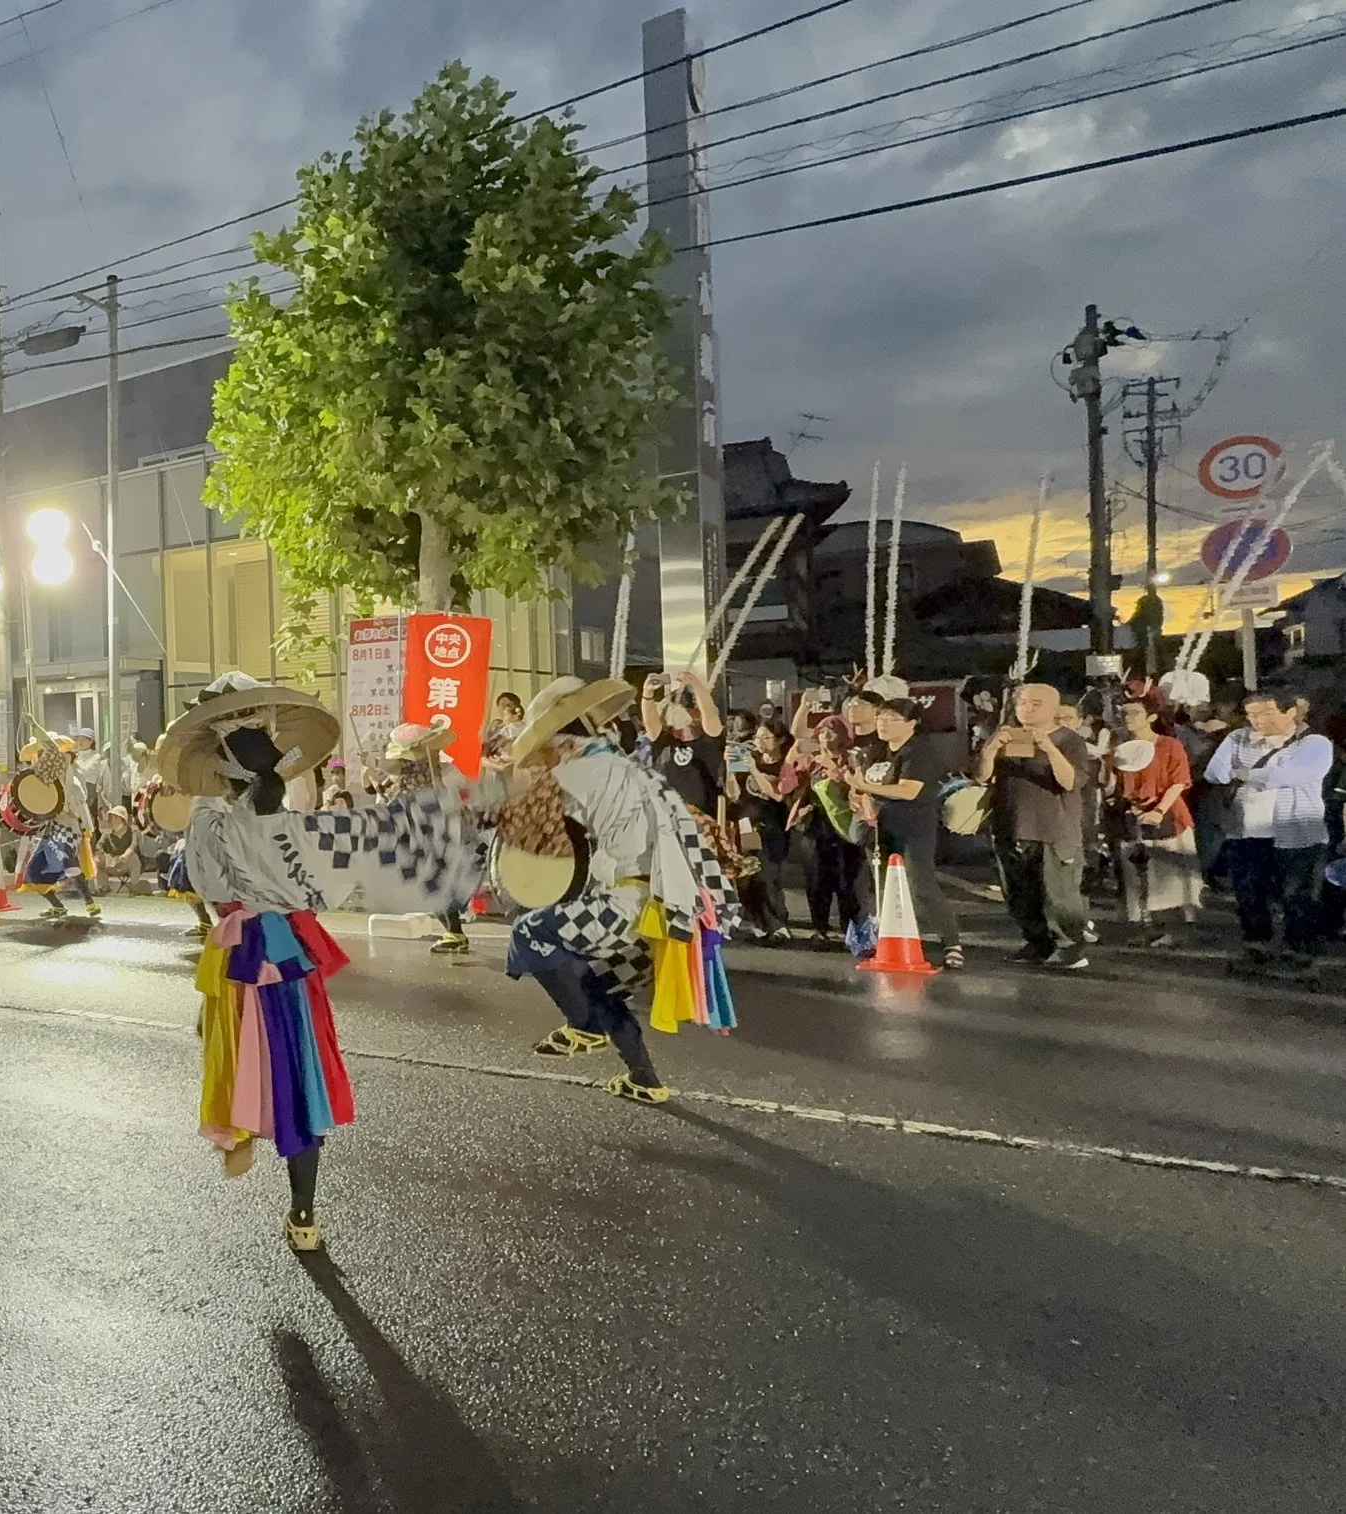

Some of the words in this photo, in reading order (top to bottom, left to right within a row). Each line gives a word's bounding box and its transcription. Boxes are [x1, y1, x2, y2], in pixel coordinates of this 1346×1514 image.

[1218, 452, 1267, 483] 30
[435, 632, 461, 646] 中央
[351, 647, 391, 661] 8月1日金
[433, 646, 460, 659] 地点
[351, 703, 391, 717] 8月2日土
